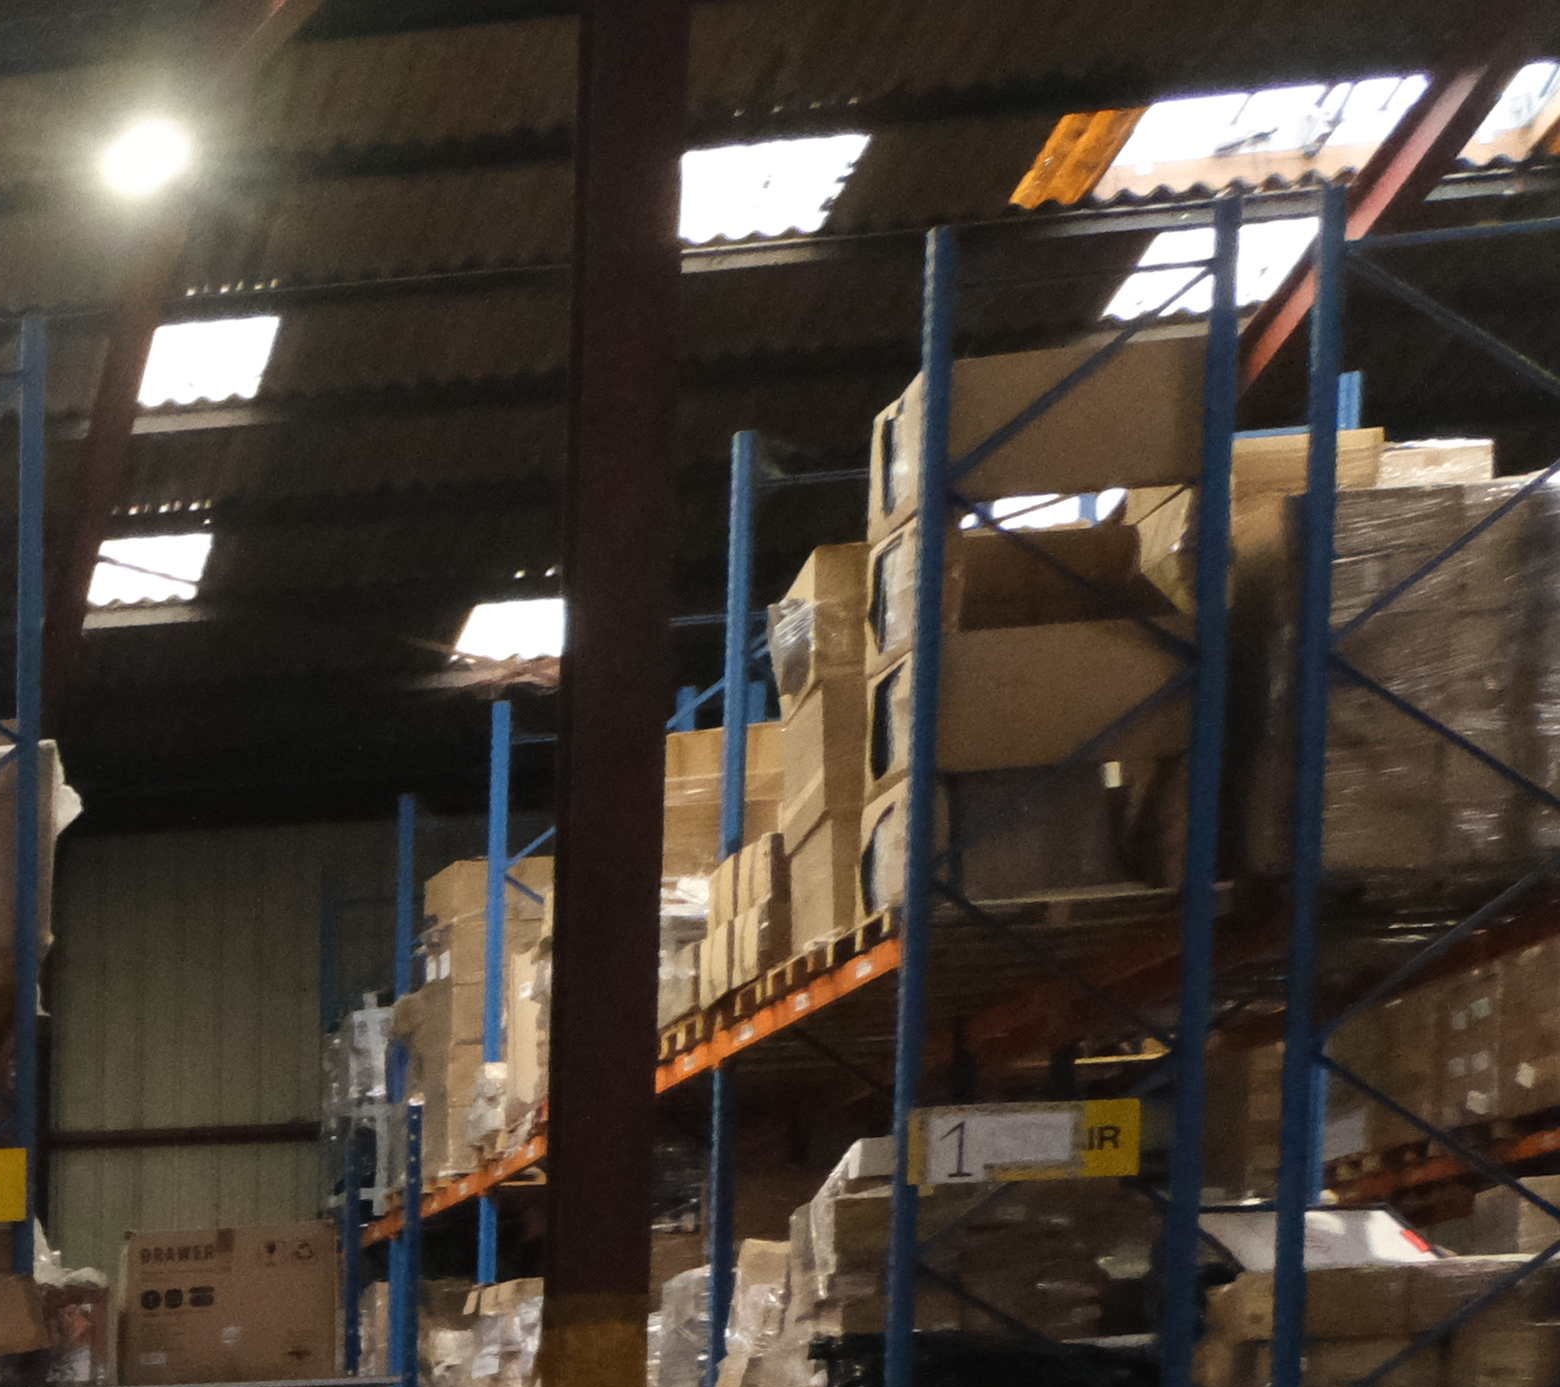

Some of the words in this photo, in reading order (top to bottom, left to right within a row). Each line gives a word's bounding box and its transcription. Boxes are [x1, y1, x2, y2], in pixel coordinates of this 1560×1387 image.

[939, 1120, 973, 1178] 1
[1086, 1124, 1121, 1151] IR
[141, 1243, 214, 1264] DRAWER
